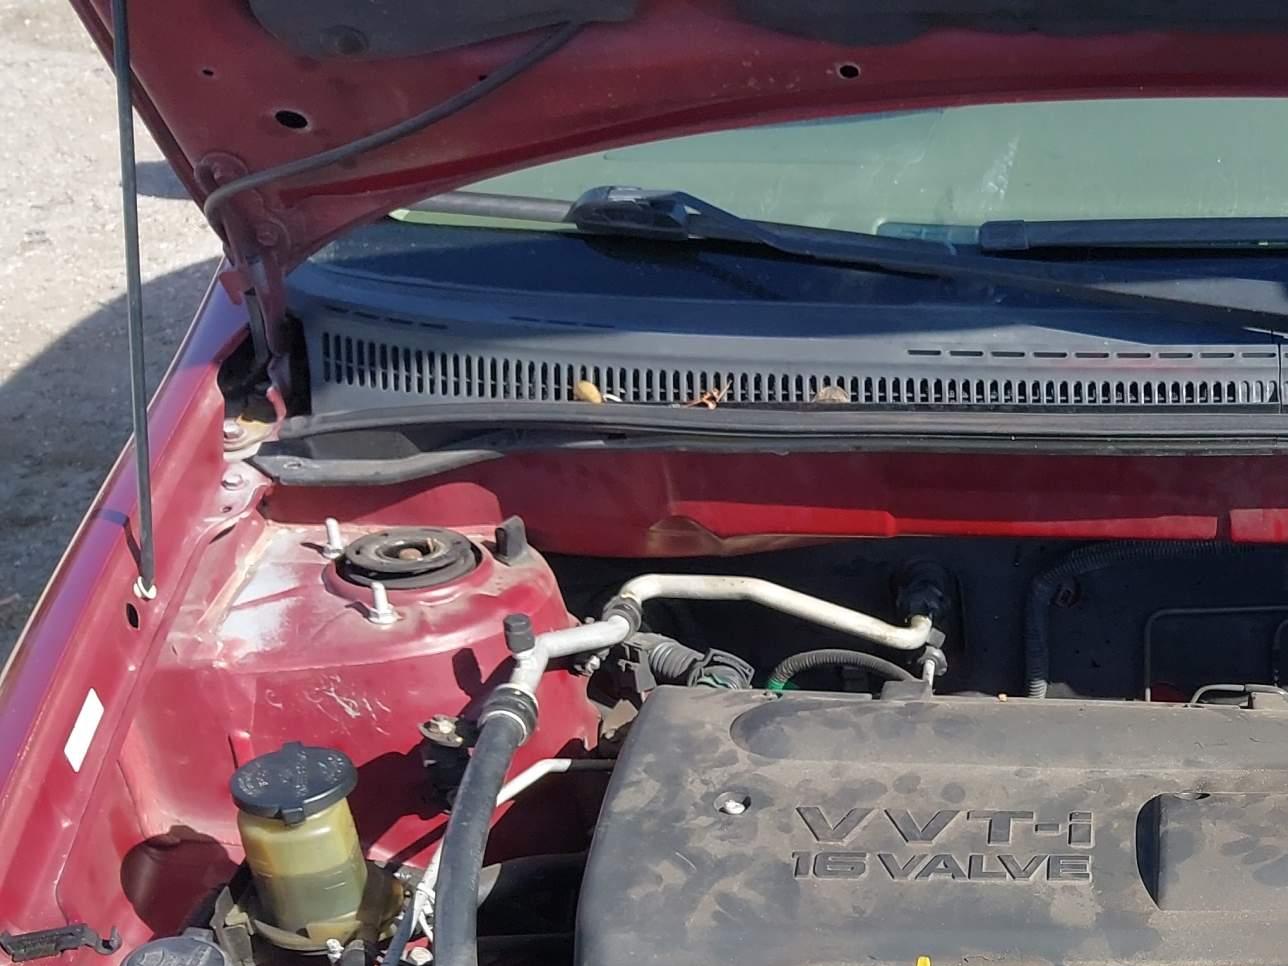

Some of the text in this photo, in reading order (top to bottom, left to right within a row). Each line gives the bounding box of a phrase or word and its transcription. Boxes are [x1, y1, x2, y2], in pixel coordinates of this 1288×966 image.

[796, 806, 1093, 847] VVT-i
[791, 851, 1093, 882] 16 VALVE
